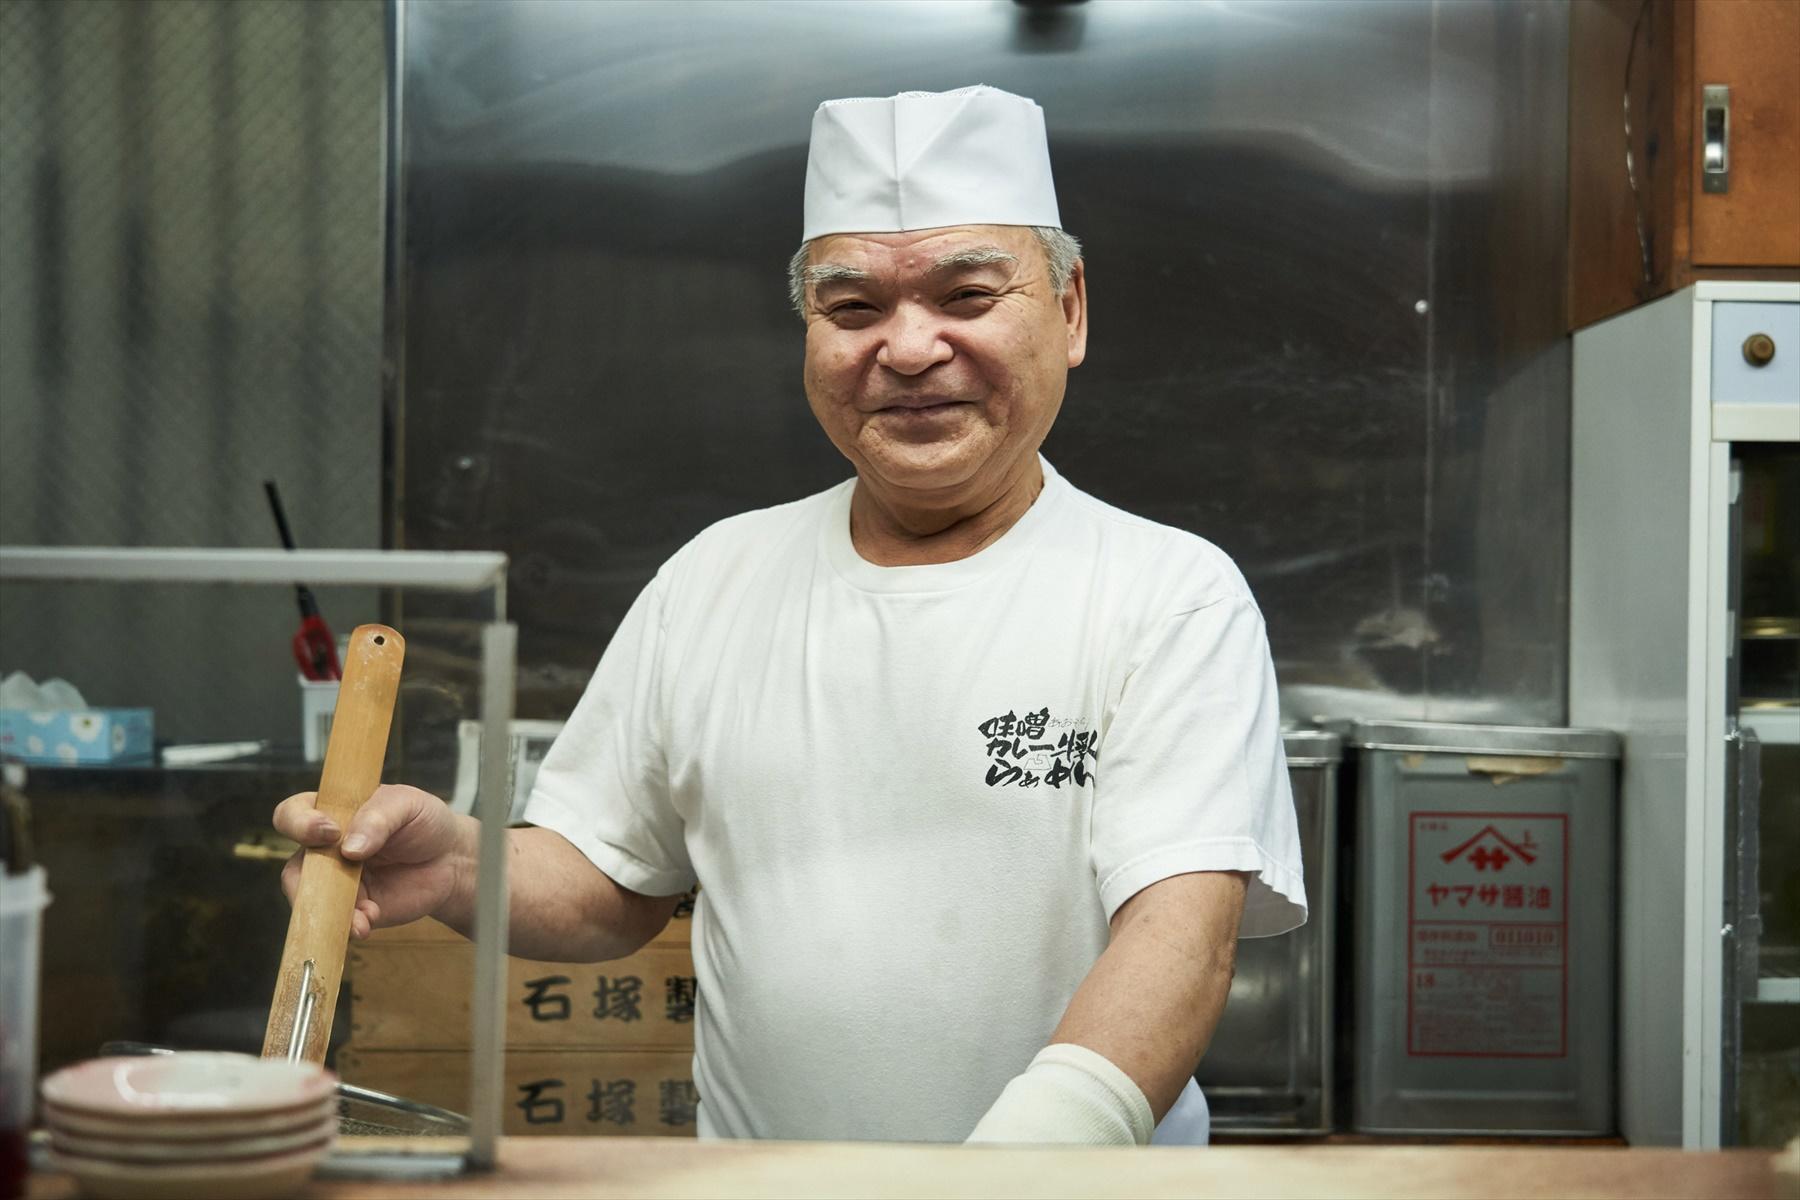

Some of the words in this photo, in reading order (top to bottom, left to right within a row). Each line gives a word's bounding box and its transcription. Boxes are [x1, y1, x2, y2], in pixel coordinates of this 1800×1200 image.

[978, 707, 1050, 740] 味噌
[1426, 882, 1553, 910] ヤマサ醤油
